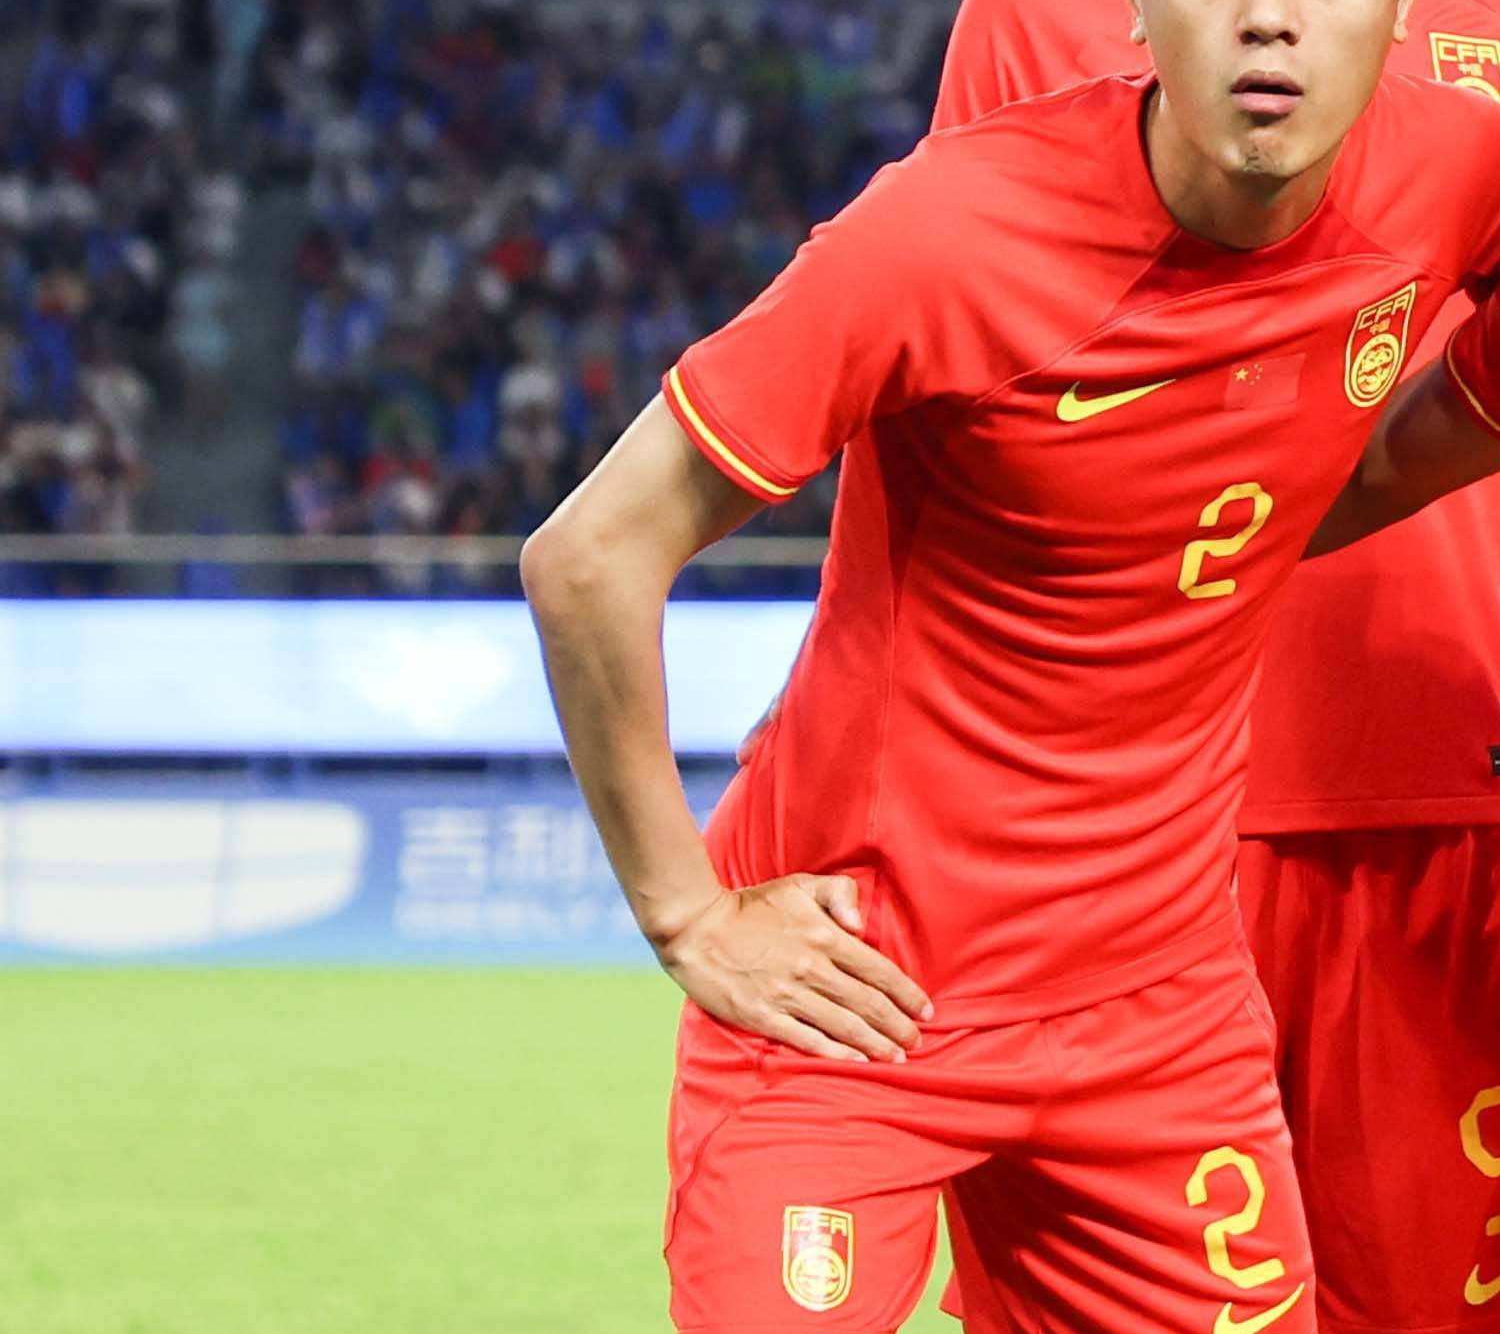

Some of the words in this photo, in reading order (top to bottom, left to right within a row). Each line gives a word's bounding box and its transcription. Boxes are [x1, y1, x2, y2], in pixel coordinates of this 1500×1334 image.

[1440, 41, 1498, 65] CFA
[1357, 294, 1411, 330] CFA
[1177, 481, 1273, 599] 2
[1185, 1145, 1285, 1289] 2
